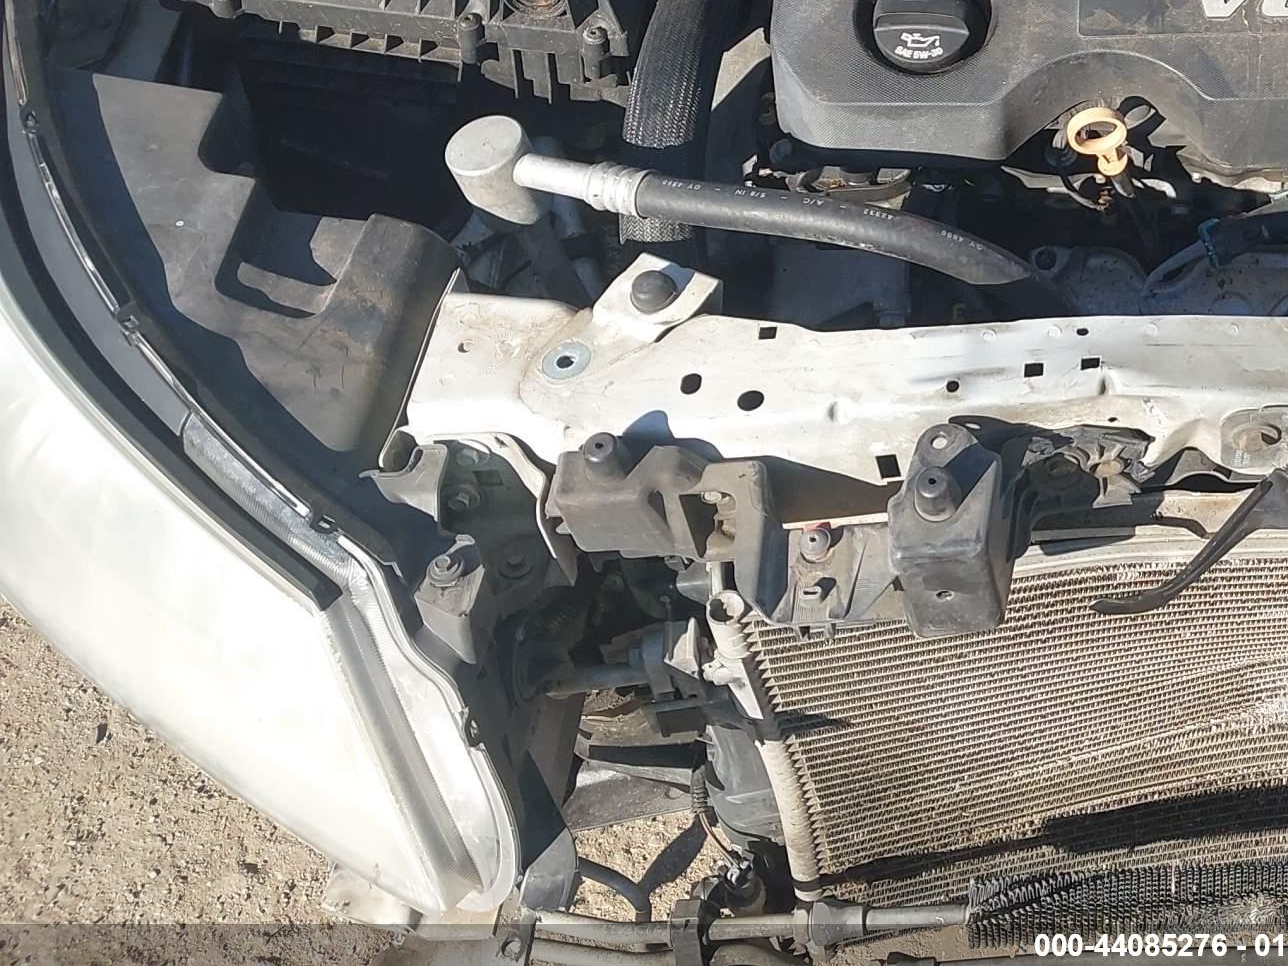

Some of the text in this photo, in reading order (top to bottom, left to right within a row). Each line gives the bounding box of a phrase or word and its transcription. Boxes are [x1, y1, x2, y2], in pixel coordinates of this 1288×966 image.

[894, 45, 944, 59] SAE 5W-30
[802, 198, 825, 207] A/C
